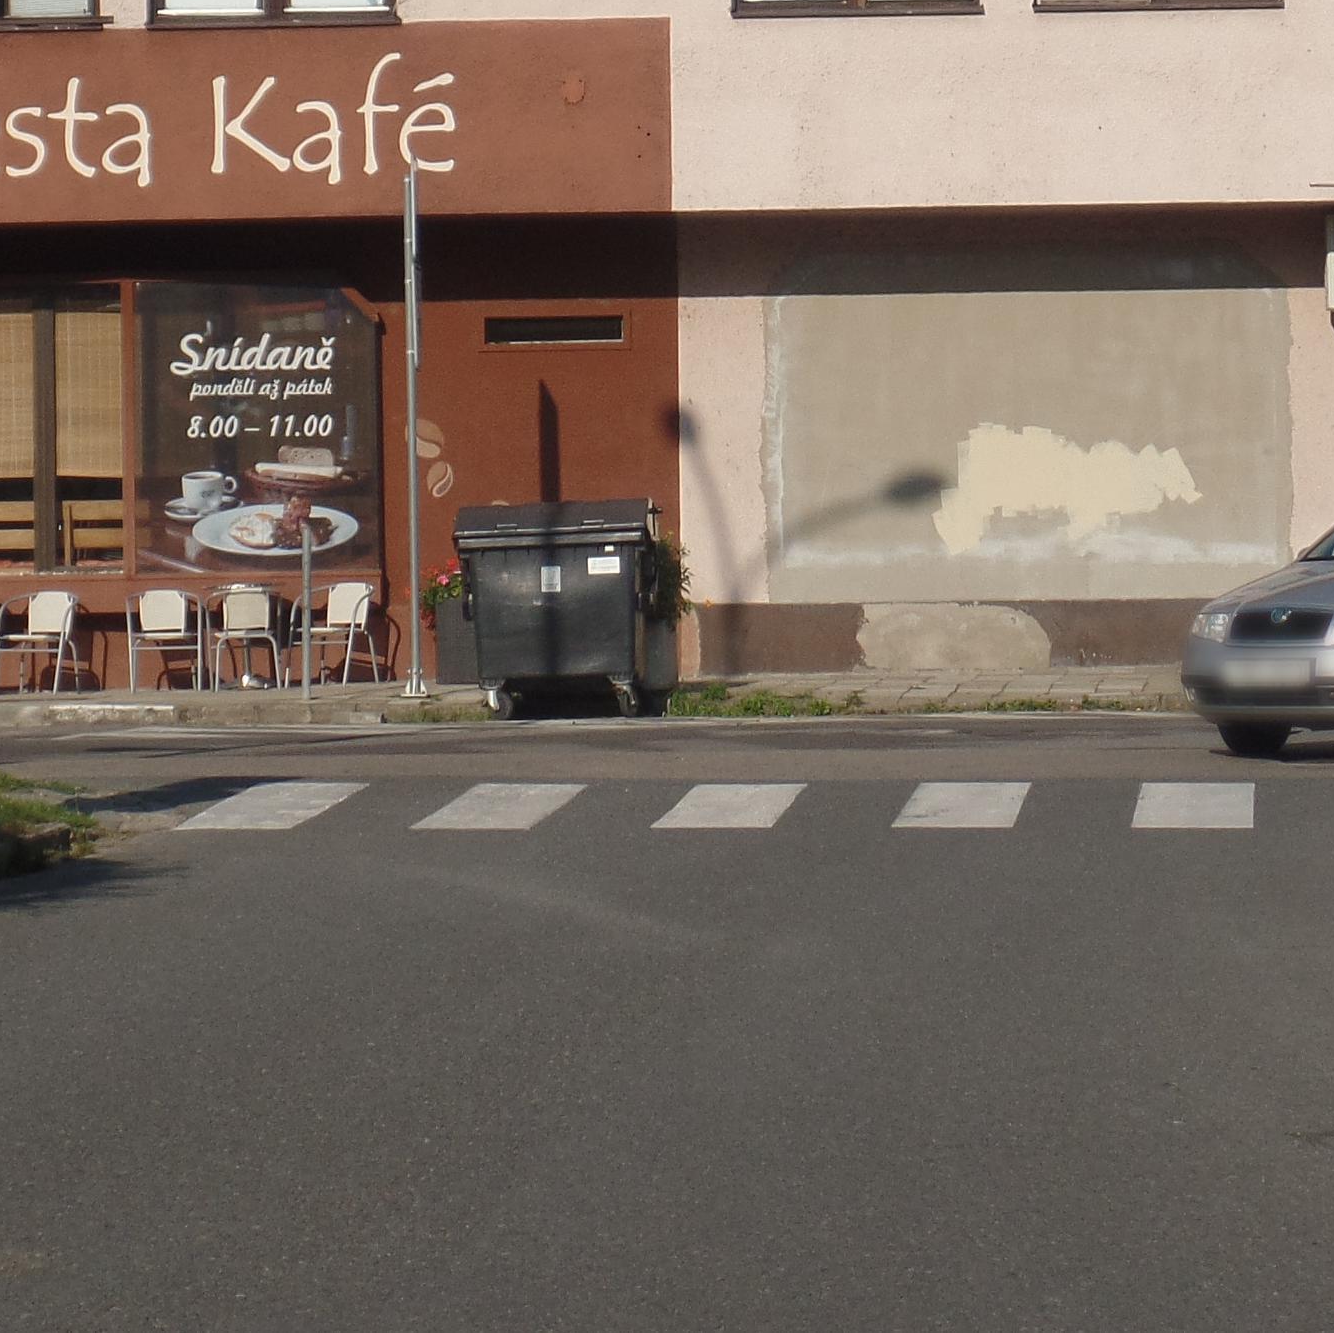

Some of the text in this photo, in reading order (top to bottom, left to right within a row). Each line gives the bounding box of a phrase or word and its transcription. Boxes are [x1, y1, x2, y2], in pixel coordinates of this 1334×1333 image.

[211, 53, 456, 184] Kafé
[170, 333, 336, 375] Snídaně
[189, 377, 333, 401] pondělí až pátek
[186, 415, 239, 438] 8.00
[269, 414, 333, 437] 11.00
